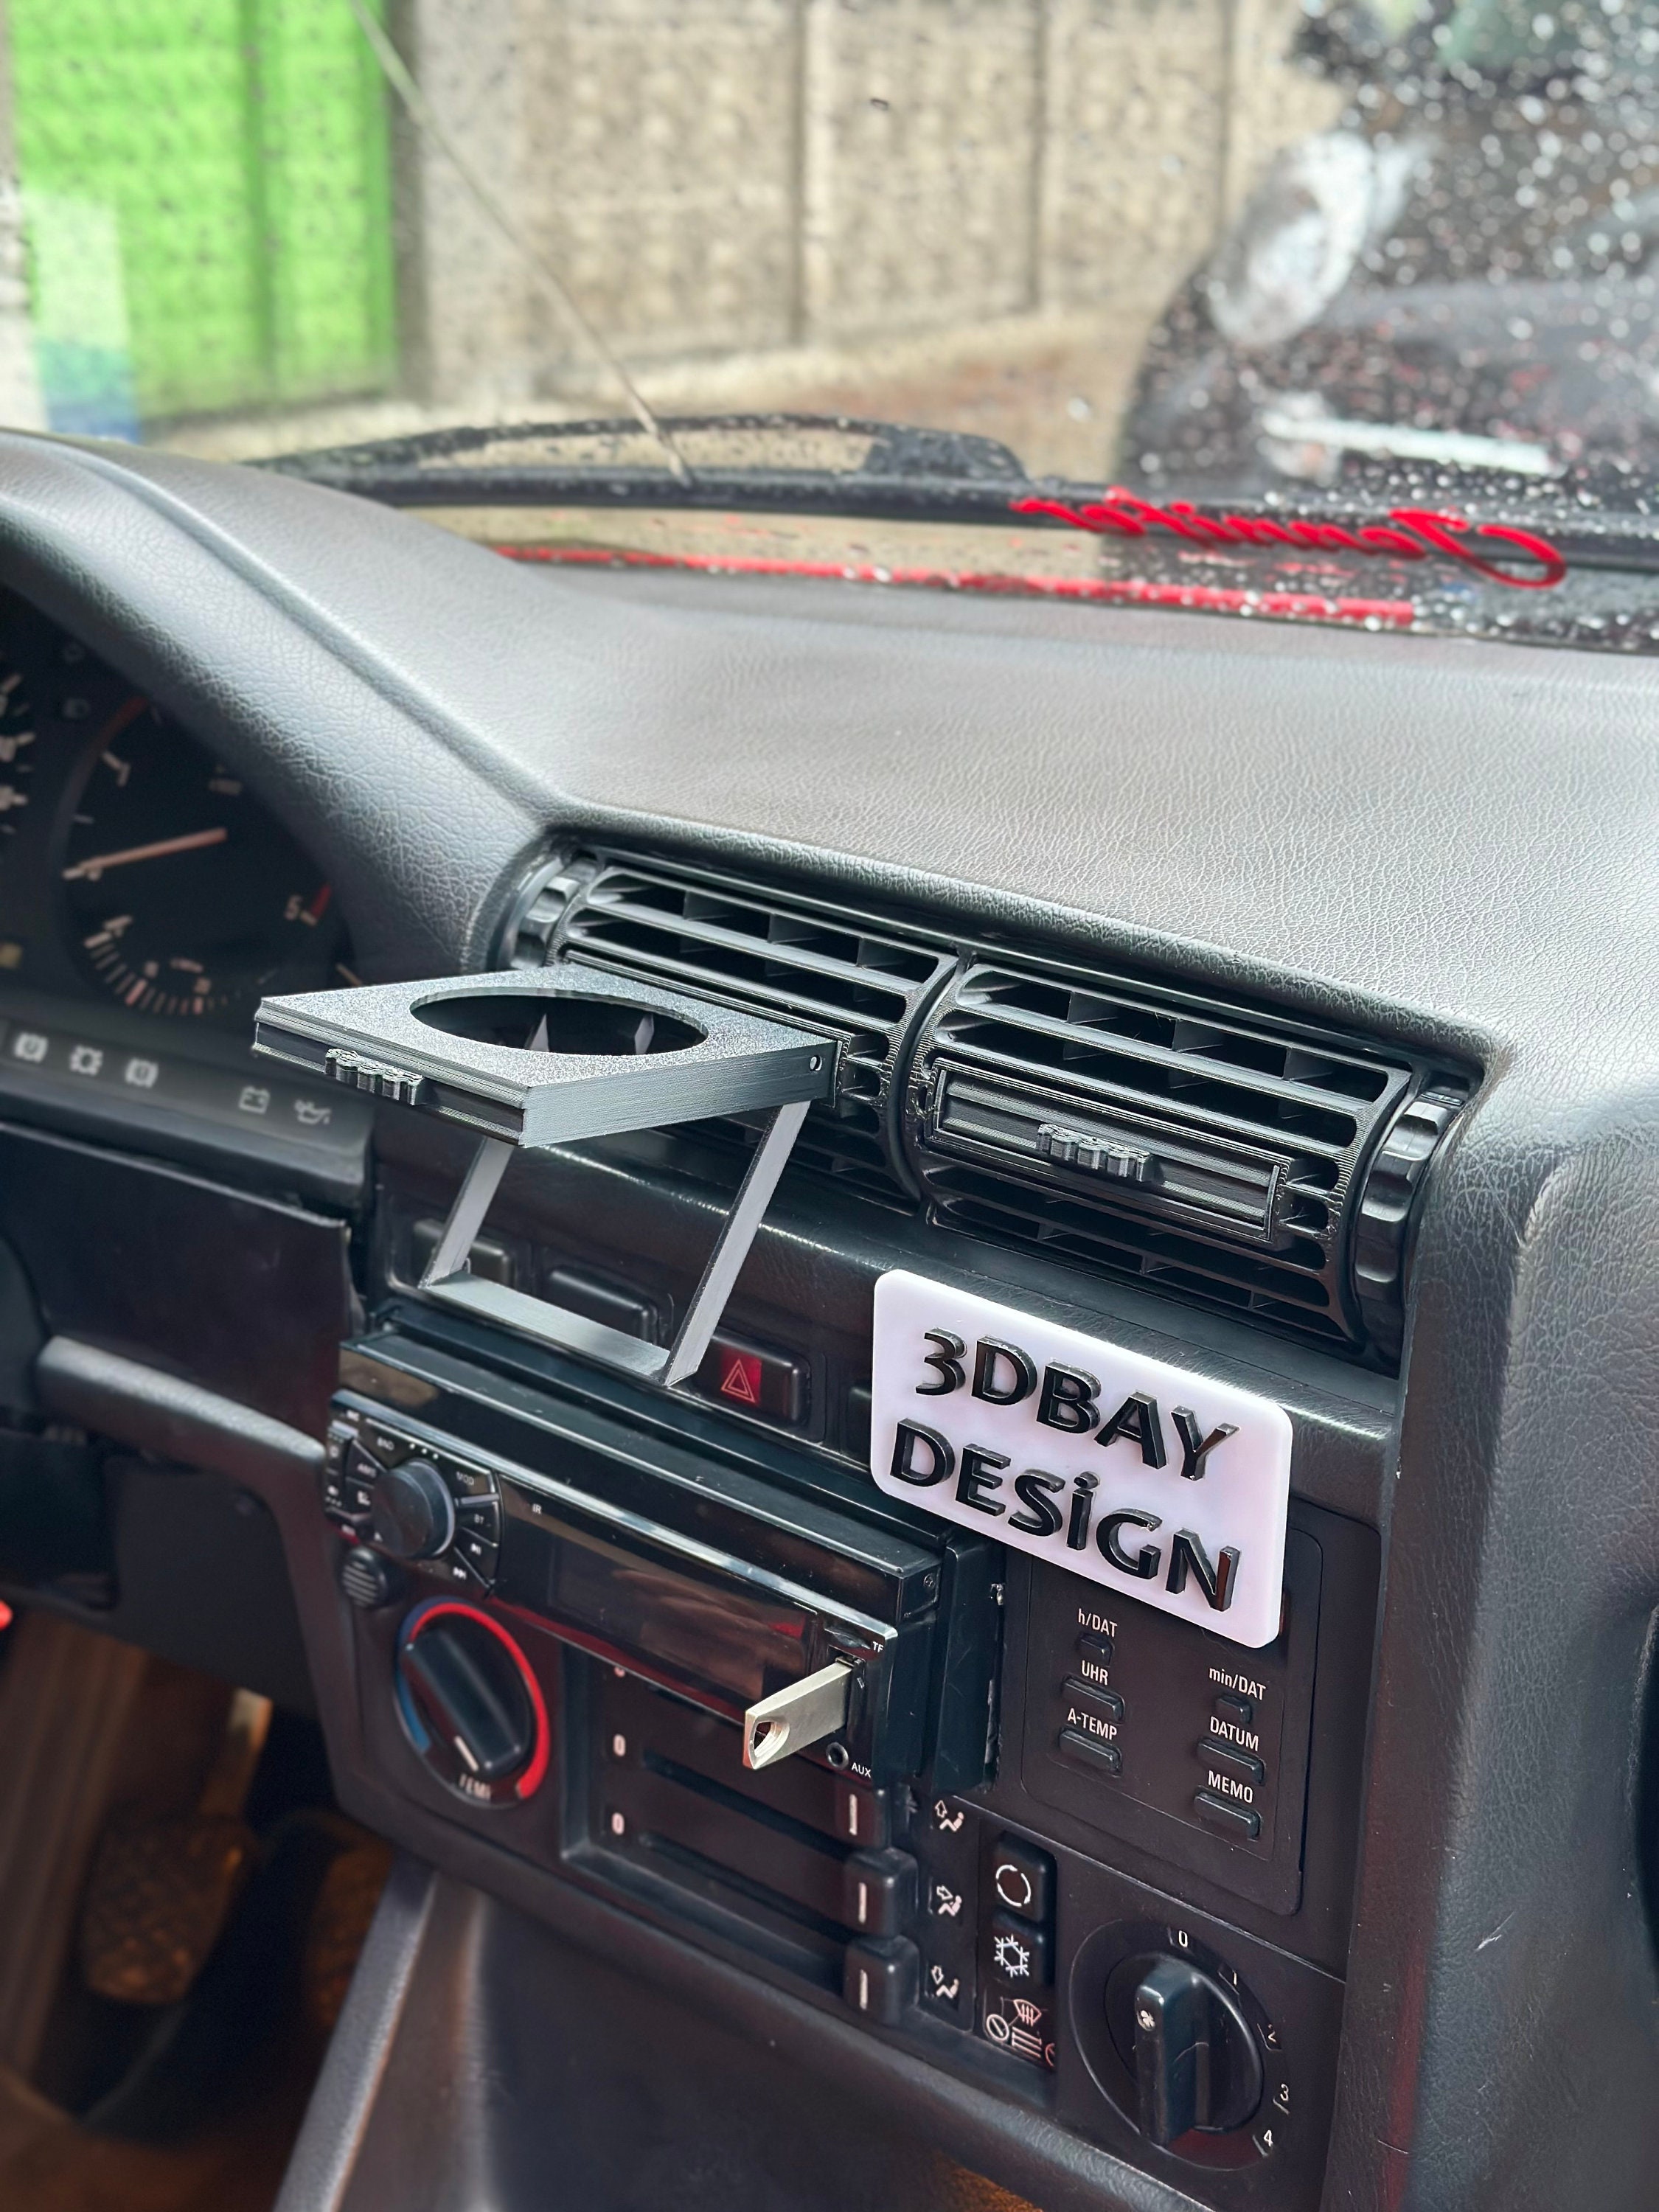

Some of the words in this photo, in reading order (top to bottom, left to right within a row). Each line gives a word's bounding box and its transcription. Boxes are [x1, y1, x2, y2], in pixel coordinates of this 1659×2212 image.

[915, 1326, 1240, 1481] 3DBAY
[532, 1503, 543, 1516] IR
[1077, 1607, 1118, 1638] h/DAT
[872, 1641, 884, 1653] TF
[1081, 1659, 1109, 1686] UHR
[1208, 1666, 1267, 1700] min/DAT
[1067, 1707, 1118, 1741] A-TEMP
[1210, 1716, 1259, 1751] DATUM
[851, 1761, 872, 1778] AUX
[1208, 1770, 1253, 1804] MEMO
[1178, 1930, 1189, 1948] 0
[1233, 1971, 1238, 1986] 1
[1267, 2024, 1276, 2043] 2
[1279, 2084, 1290, 2102] 3
[1263, 2130, 1273, 2147] 4
